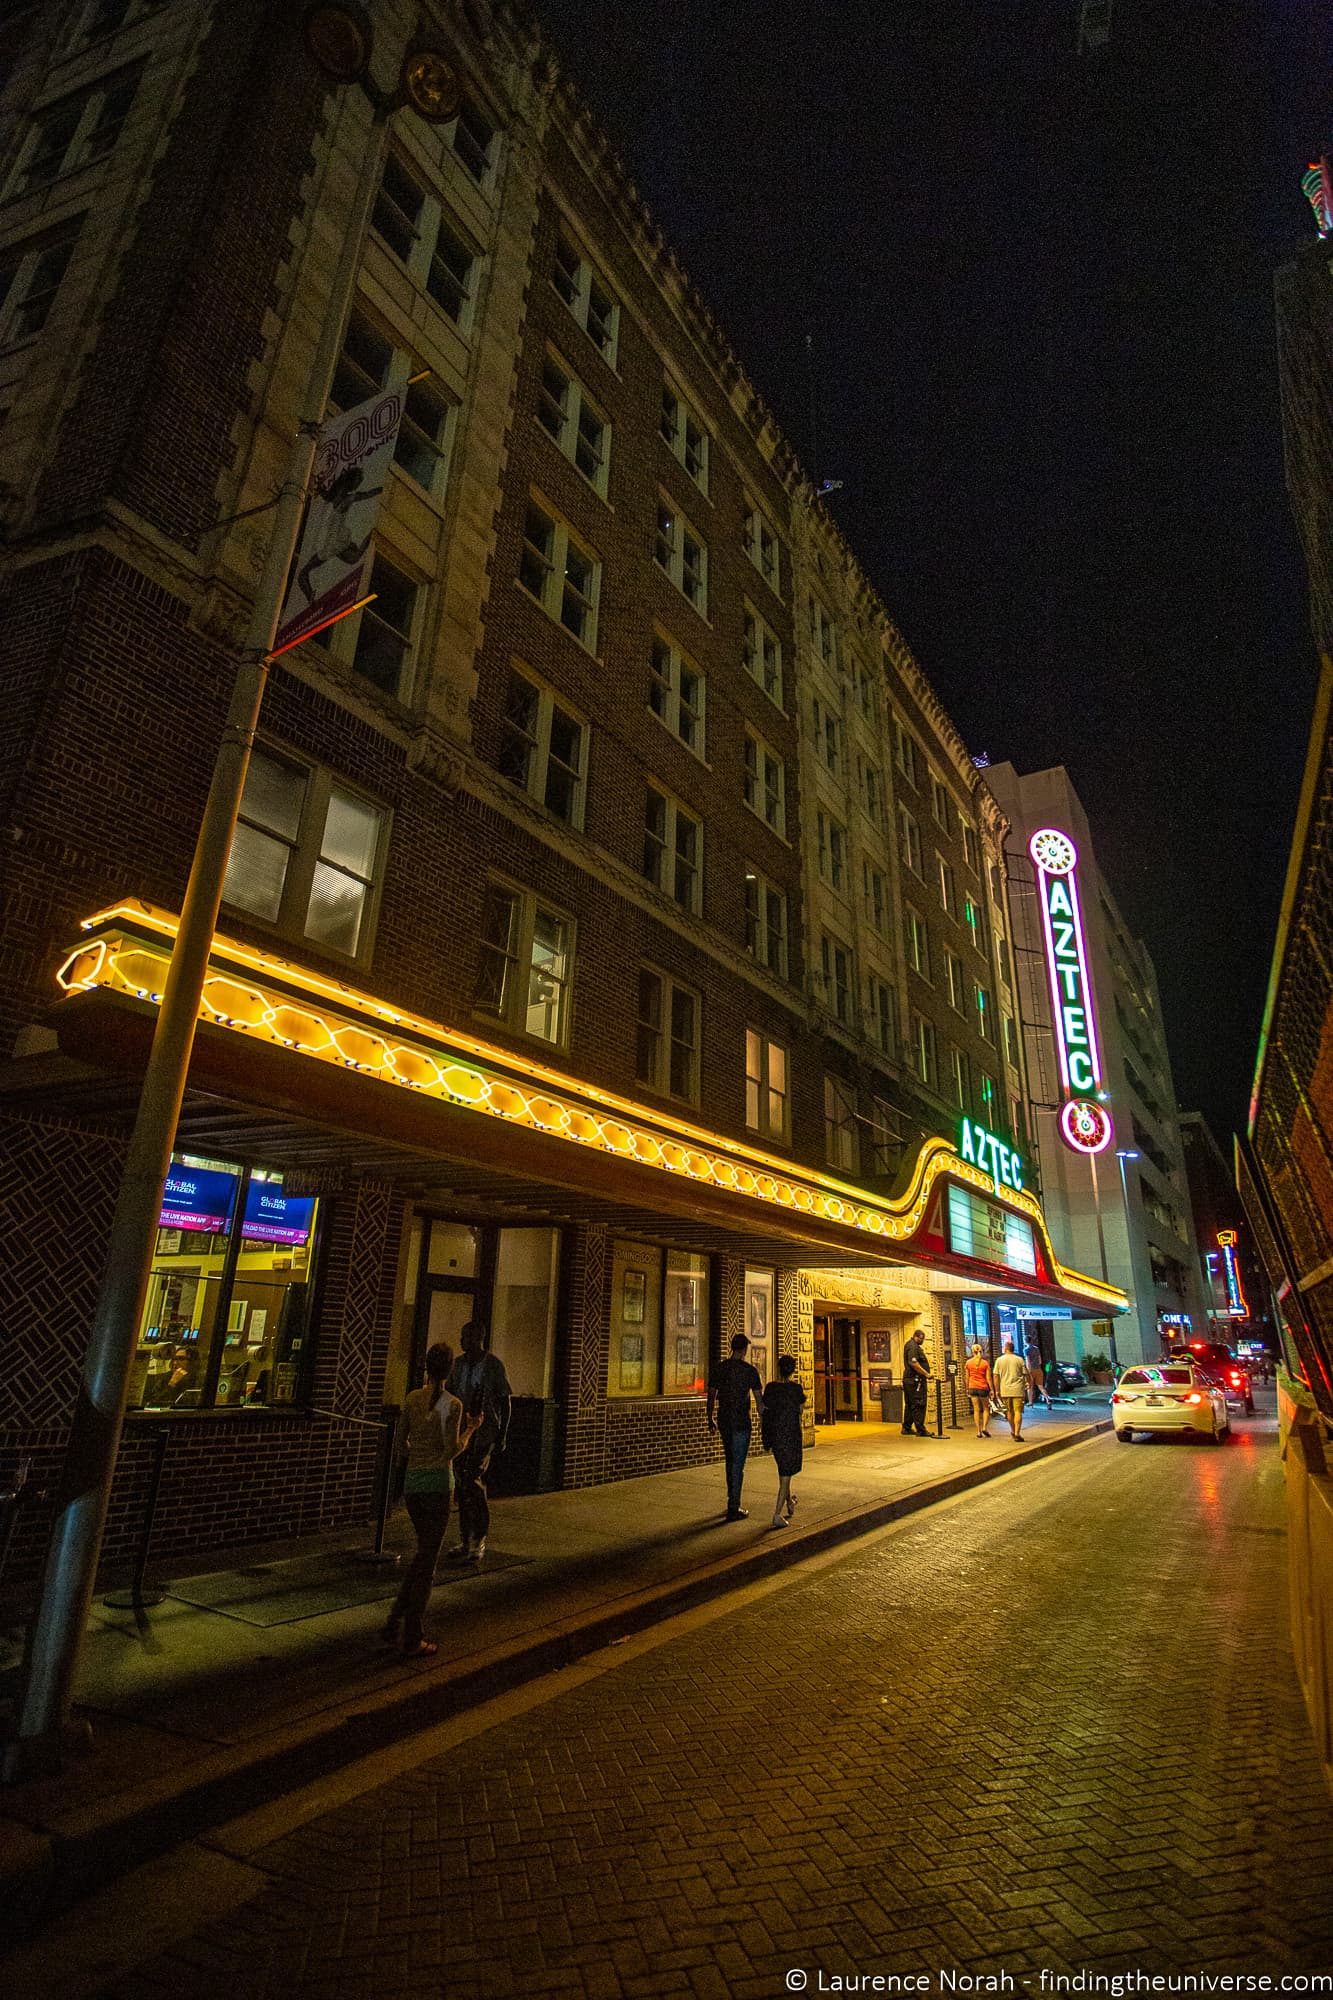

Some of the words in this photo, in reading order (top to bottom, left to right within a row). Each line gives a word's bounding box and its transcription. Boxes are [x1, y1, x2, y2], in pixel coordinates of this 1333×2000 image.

[317, 395, 401, 483] 300
[1049, 881, 1094, 1090] AZTEC
[961, 1117, 1023, 1198] AZTEC
[260, 1201, 286, 1210] CITIZEN
[261, 1196, 286, 1205] GLOBAL
